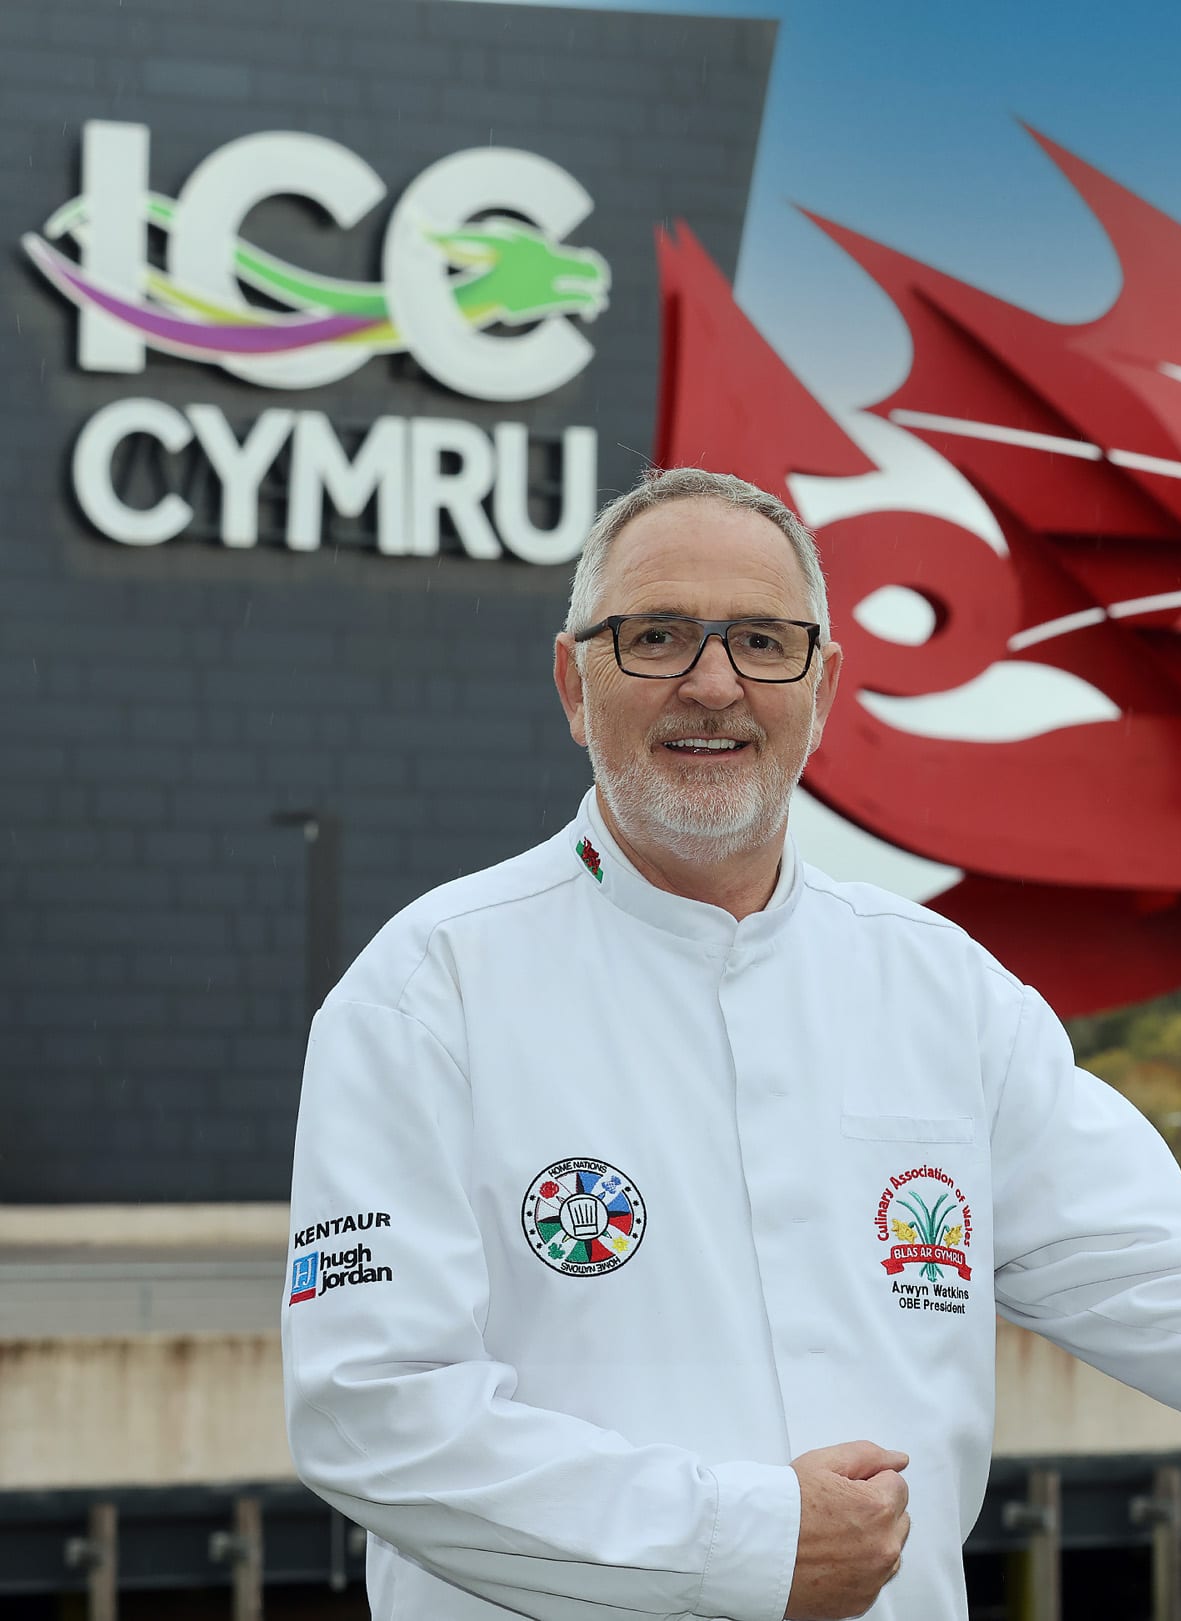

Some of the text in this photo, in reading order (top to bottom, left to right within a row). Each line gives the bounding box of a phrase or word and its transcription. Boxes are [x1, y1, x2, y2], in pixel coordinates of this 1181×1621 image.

[79, 119, 596, 401] ICC
[73, 397, 598, 566] CYMRU
[548, 1161, 608, 1178] HOME NATIONS
[874, 1187, 894, 1242] Culinary
[889, 1164, 954, 1190] Association
[955, 1188, 966, 1202] of
[294, 1212, 391, 1249] KENTAUR
[320, 1243, 372, 1271] hugh
[560, 1256, 621, 1274] HOME NATIONS
[893, 1247, 964, 1264] BLAS AR GYMRU
[318, 1263, 393, 1297] jordan
[892, 1280, 969, 1300] Arwyn Watkins
[899, 1297, 966, 1314] OBE President
